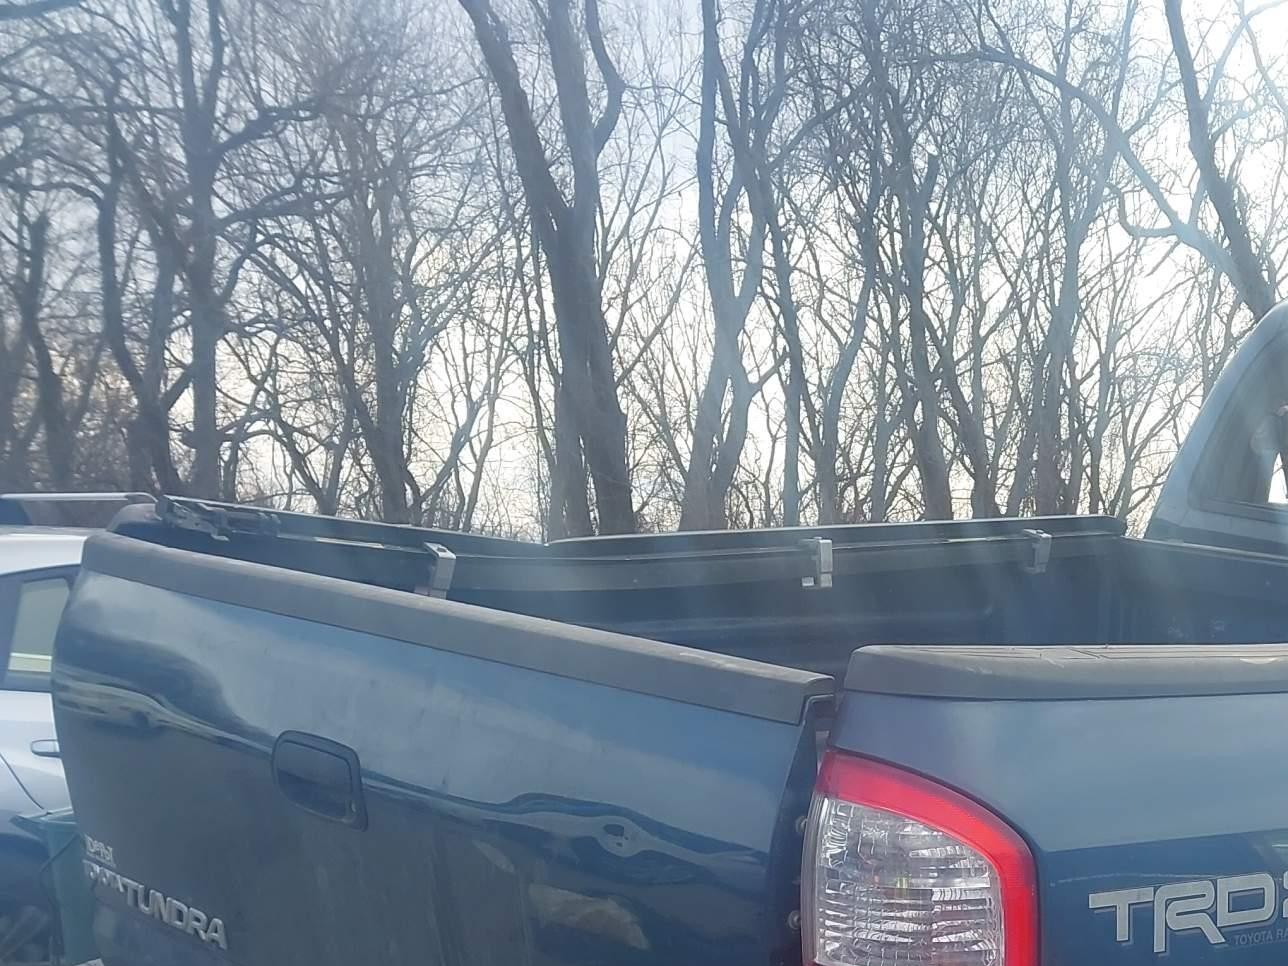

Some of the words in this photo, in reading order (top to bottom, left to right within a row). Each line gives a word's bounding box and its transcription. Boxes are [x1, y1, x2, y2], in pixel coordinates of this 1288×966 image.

[121, 876, 228, 950] TUNDRA
[1088, 872, 1277, 954] TRD
[1234, 930, 1273, 946] TOYOTA
